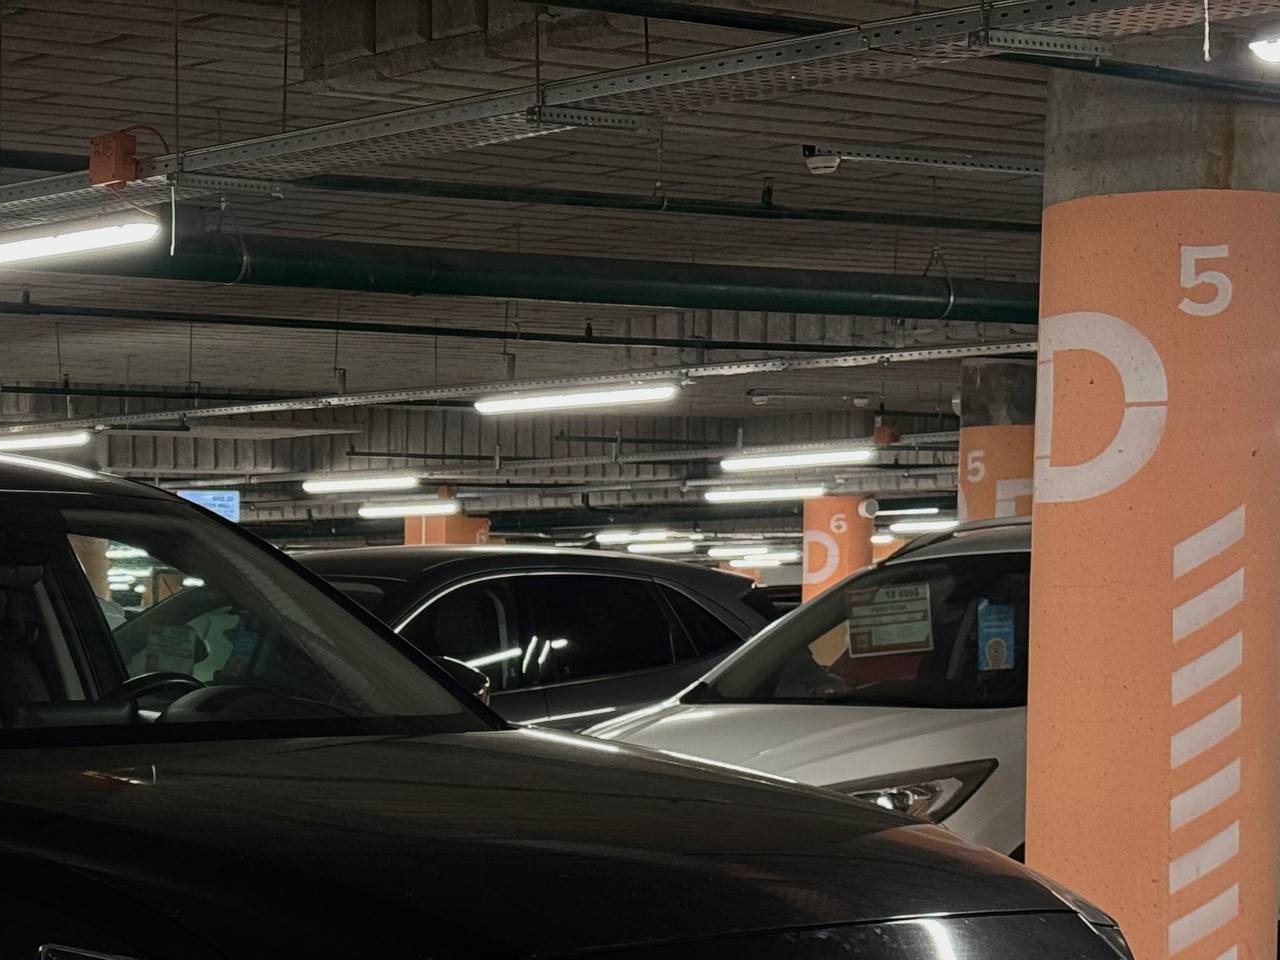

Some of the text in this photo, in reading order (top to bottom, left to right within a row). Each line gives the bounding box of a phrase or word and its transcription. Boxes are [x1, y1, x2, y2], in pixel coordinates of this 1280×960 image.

[1177, 245, 1232, 316] 5
[1034, 312, 1168, 502] D
[967, 450, 986, 483] 5
[830, 513, 847, 533] 6
[803, 530, 840, 584] D
